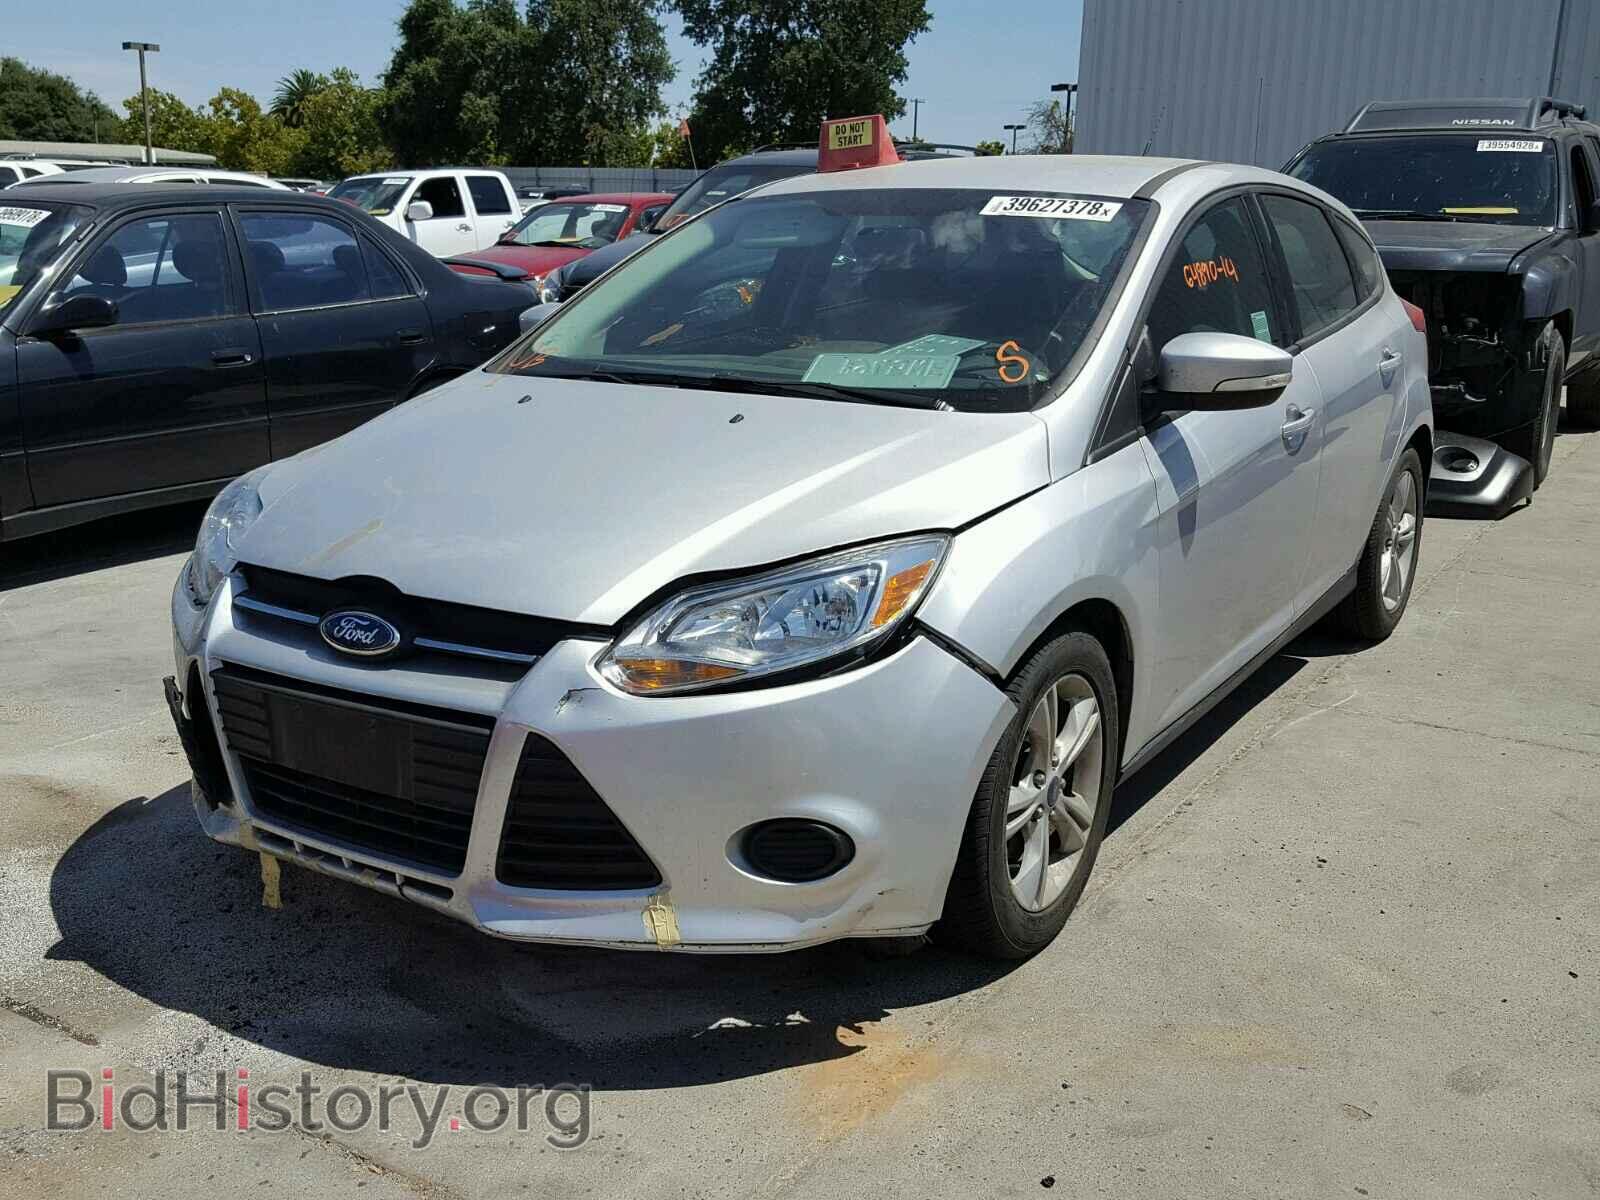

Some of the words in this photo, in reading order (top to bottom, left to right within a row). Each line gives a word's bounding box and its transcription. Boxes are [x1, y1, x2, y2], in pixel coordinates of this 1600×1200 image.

[835, 124, 847, 136] DO
[849, 121, 865, 134] NOT
[837, 134, 864, 147] START
[333, 616, 380, 645] Ford
